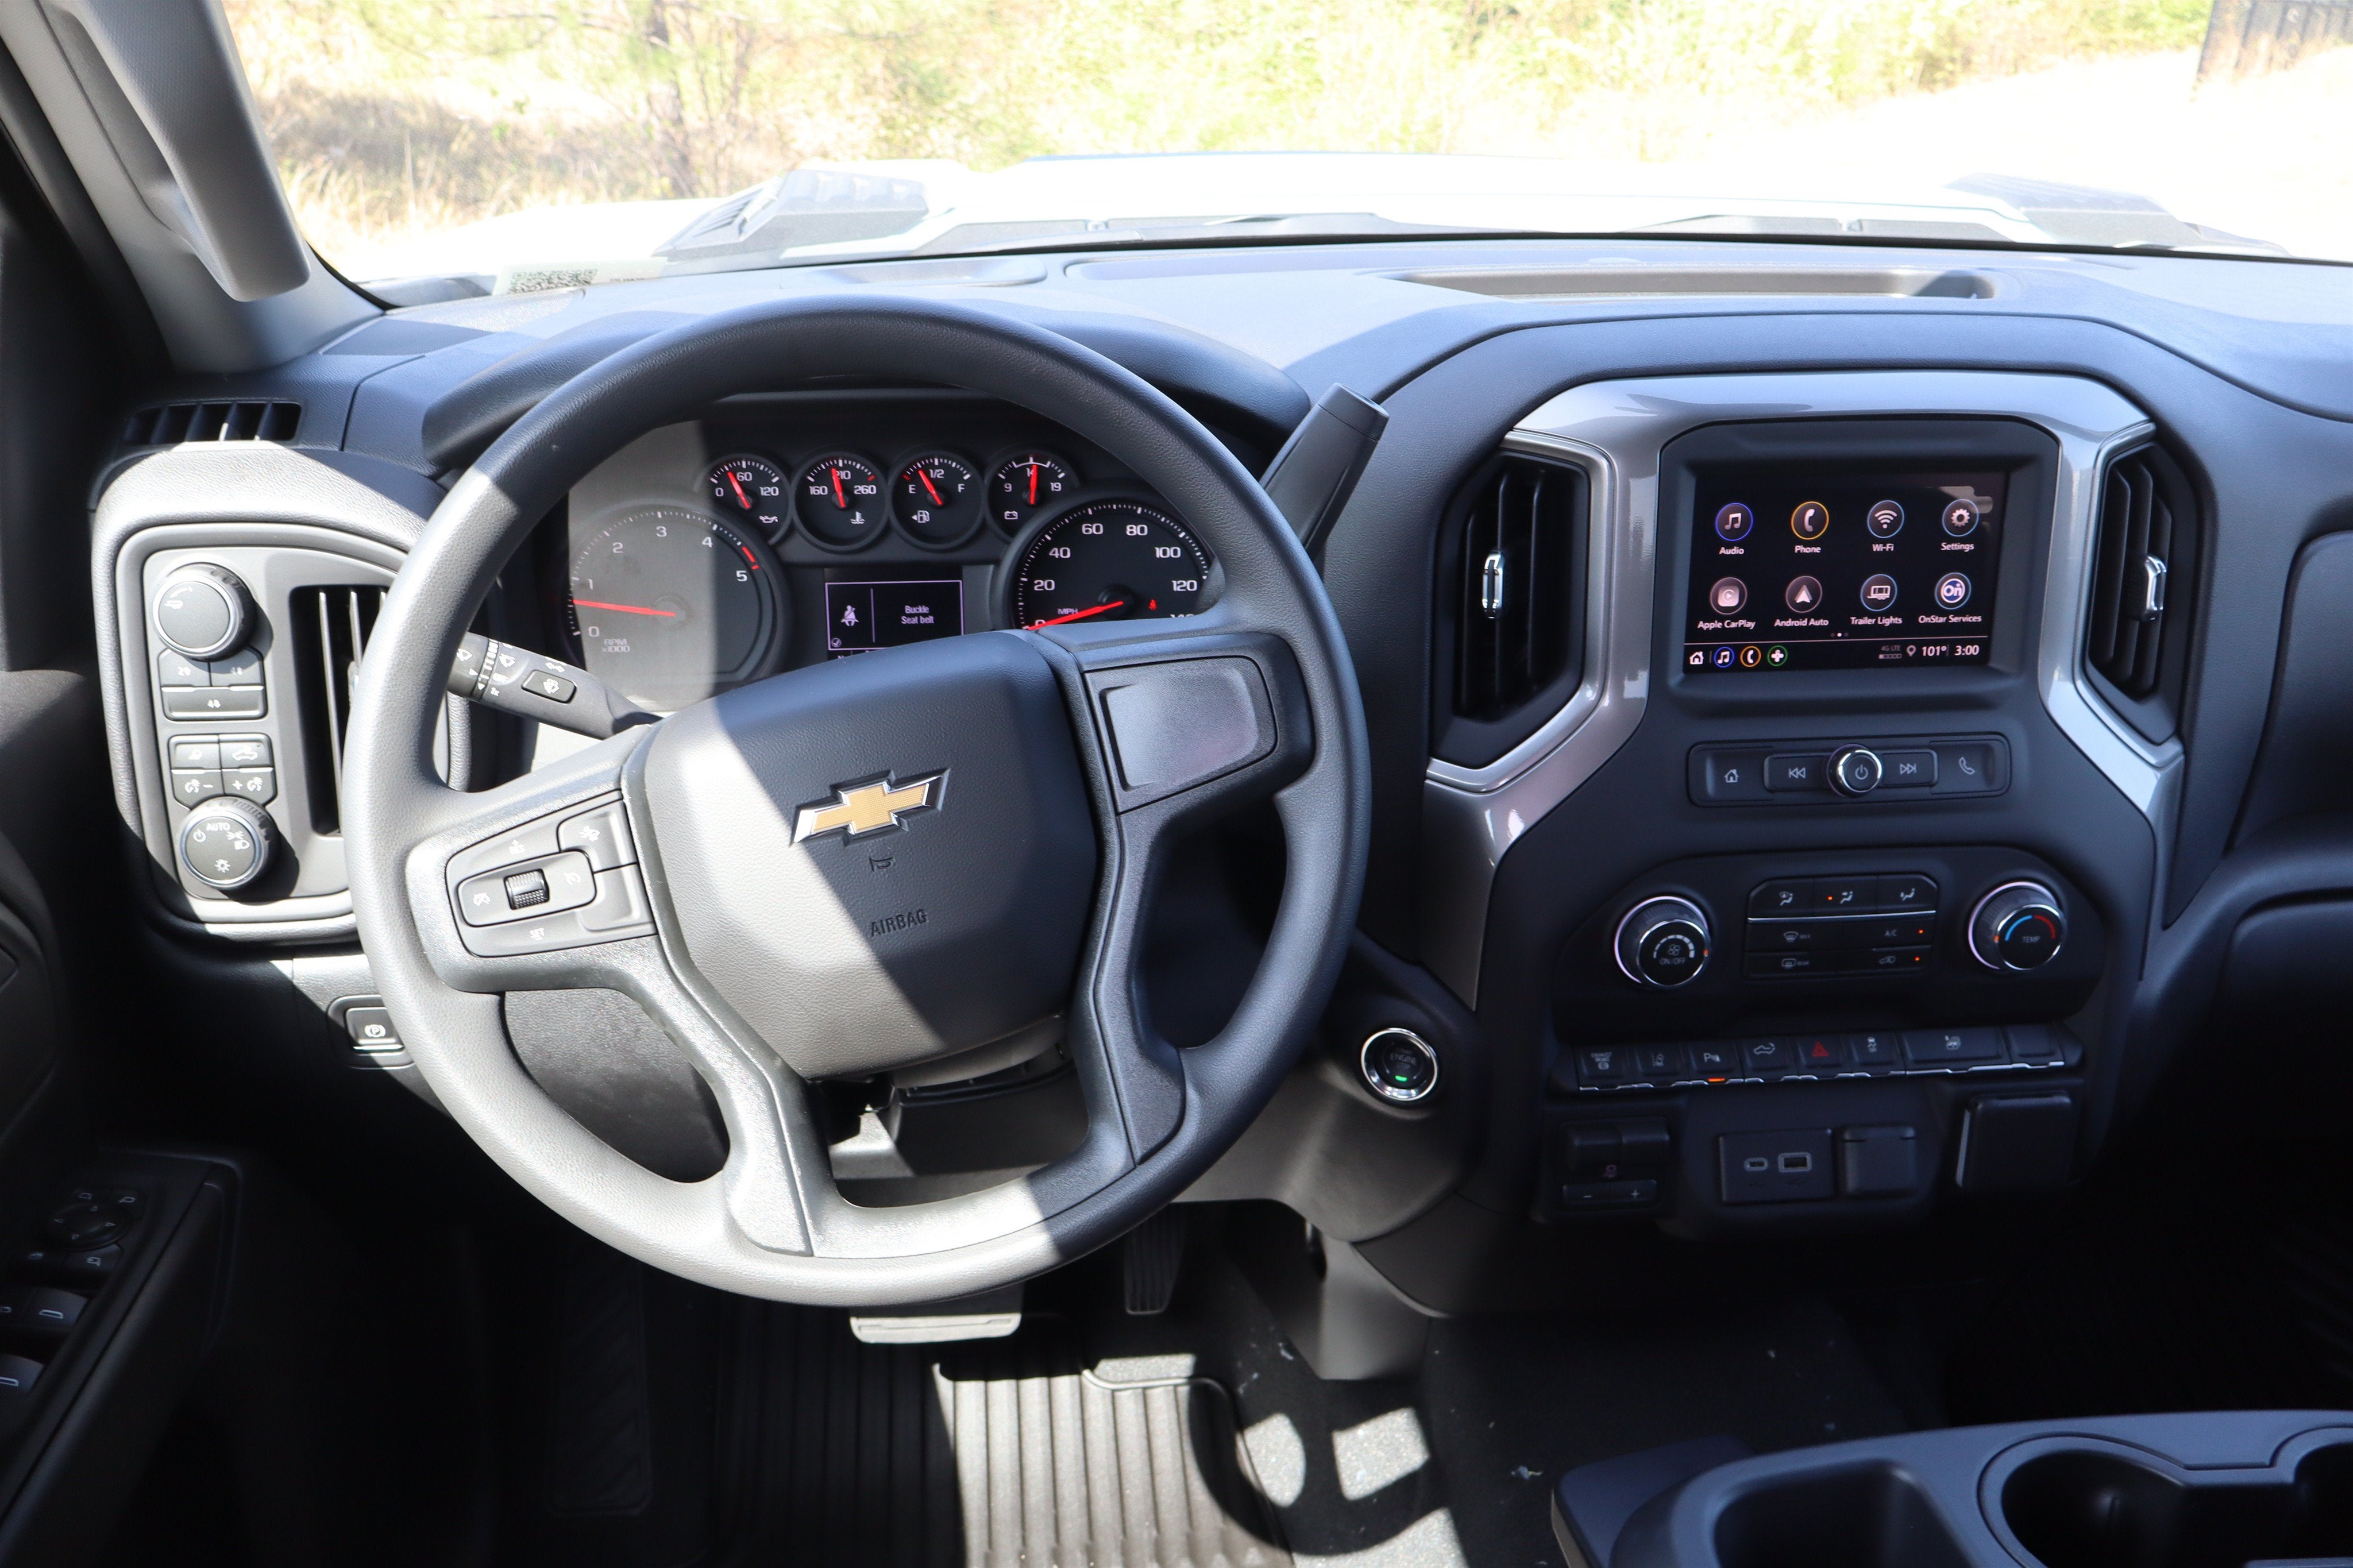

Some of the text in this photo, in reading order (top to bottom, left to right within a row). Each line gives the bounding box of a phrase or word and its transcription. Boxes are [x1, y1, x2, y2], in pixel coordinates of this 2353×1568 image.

[736, 472, 753, 481] 60
[929, 469, 944, 478] 1/2
[759, 486, 779, 496] 120
[809, 486, 828, 495] 160
[854, 485, 877, 495] 260
[908, 484, 916, 494] E
[958, 484, 965, 493] F
[1004, 483, 1012, 492] 9
[1050, 482, 1062, 492] 19
[715, 488, 724, 497] 0
[656, 526, 667, 537] 3
[1082, 523, 1104, 534] 60
[1126, 524, 1148, 536] 80
[701, 536, 713, 547] 4
[612, 542, 623, 553] 2
[1719, 546, 1744, 555] Audio
[1795, 545, 1821, 553] Phone
[1872, 543, 1894, 551] Wi-Fi
[1941, 542, 1974, 552] Settings
[1049, 547, 1071, 558] 40
[1155, 547, 1181, 558] 100
[736, 570, 747, 581] 5
[588, 579, 594, 589] 1
[1034, 580, 1055, 591] 20
[1172, 580, 1198, 591] 120
[905, 605, 929, 614] Buckle
[901, 615, 934, 624] Seat belt
[1774, 618, 1829, 627] Android Auto
[1850, 616, 1903, 626] Trailer Lights
[1918, 615, 1982, 623] OnStar Services
[1698, 620, 1756, 630] Apple CarPlay
[588, 626, 600, 637] 0
[1954, 645, 1980, 655] 3:00
[206, 822, 230, 831] AUTO
[870, 909, 927, 937] AIRBAG
